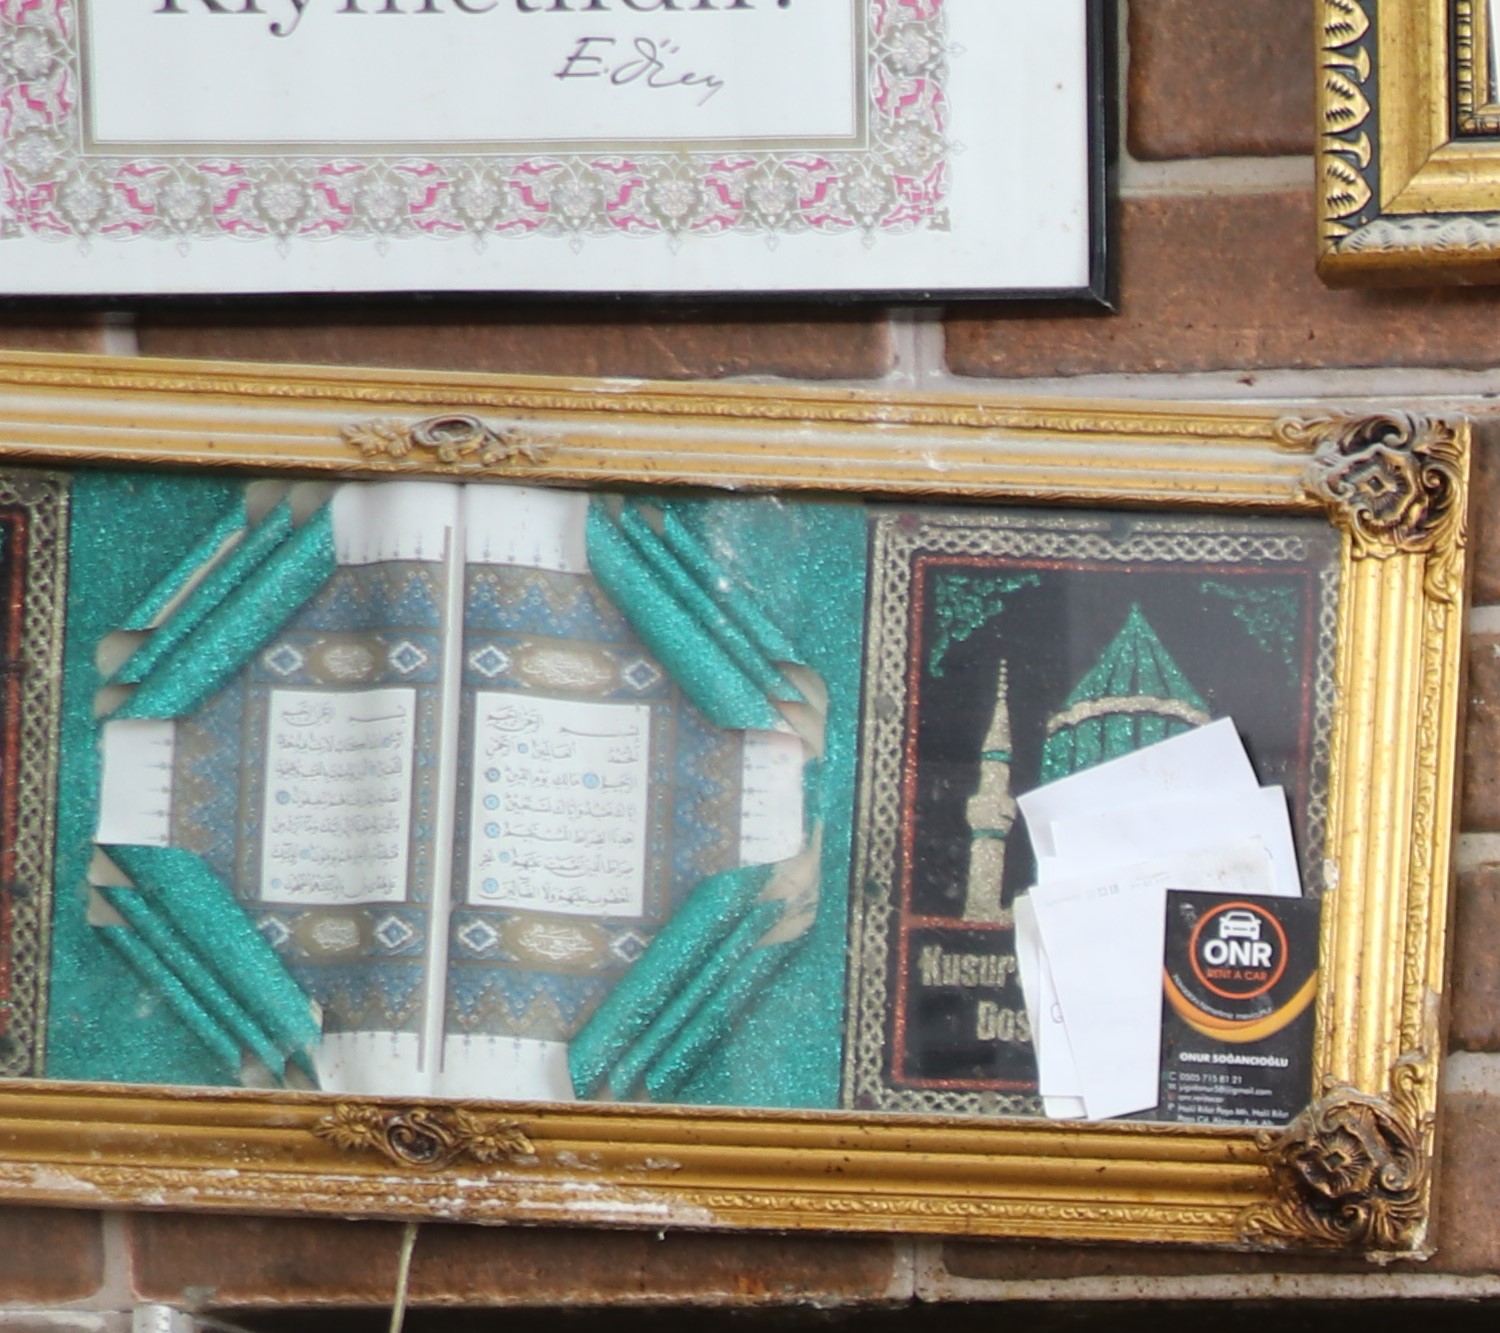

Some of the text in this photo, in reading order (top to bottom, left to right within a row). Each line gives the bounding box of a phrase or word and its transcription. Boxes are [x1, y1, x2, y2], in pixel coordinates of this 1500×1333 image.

[1203, 939, 1272, 967] ONR
[918, 944, 1022, 988] Kusur
[1207, 968, 1268, 981] RENT A CAR
[1179, 1052, 1211, 1063] ONUR
